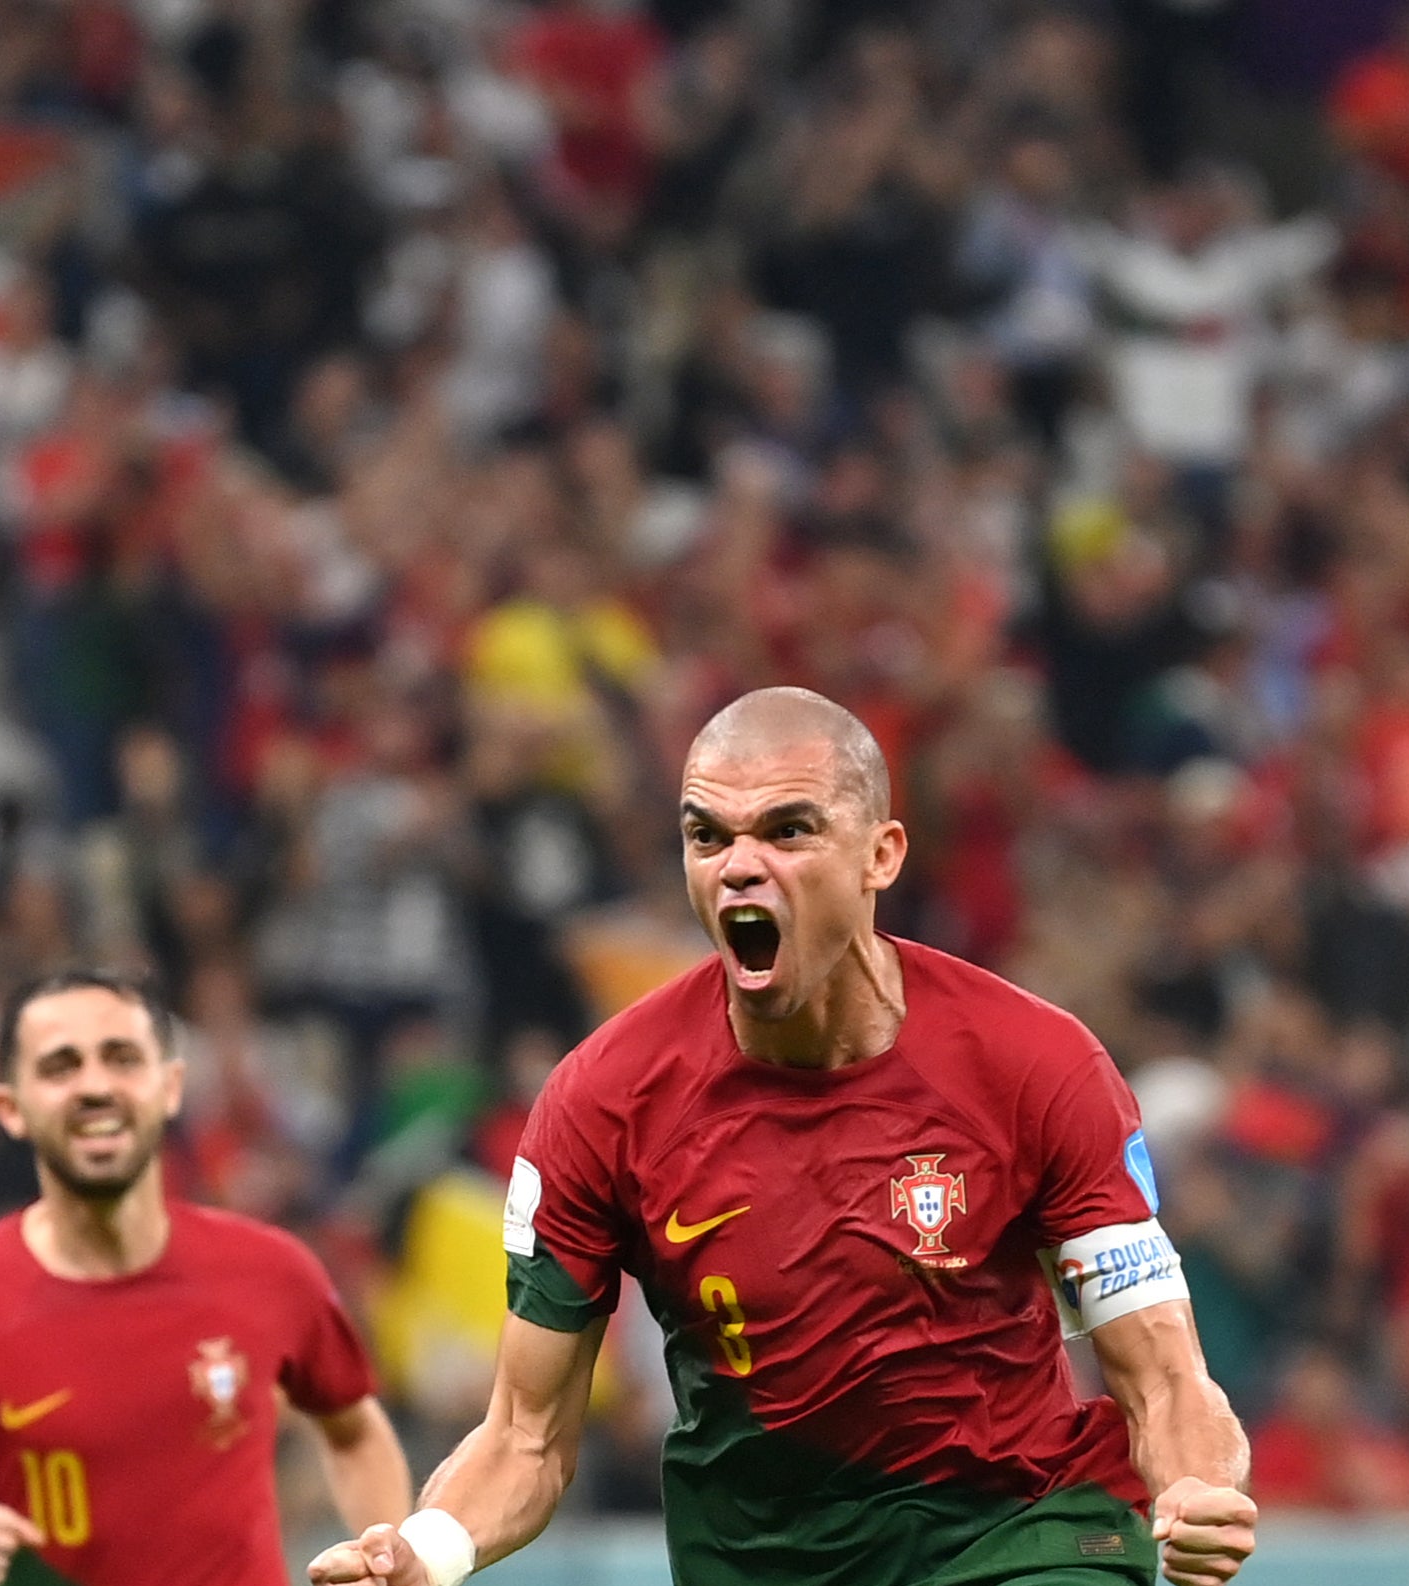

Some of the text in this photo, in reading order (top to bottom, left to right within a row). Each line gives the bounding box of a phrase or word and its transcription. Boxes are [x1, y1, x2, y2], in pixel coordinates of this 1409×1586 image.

[699, 1275, 752, 1375] 3
[1099, 1259, 1173, 1300] FOR ALL
[20, 1450, 90, 1547] 10
